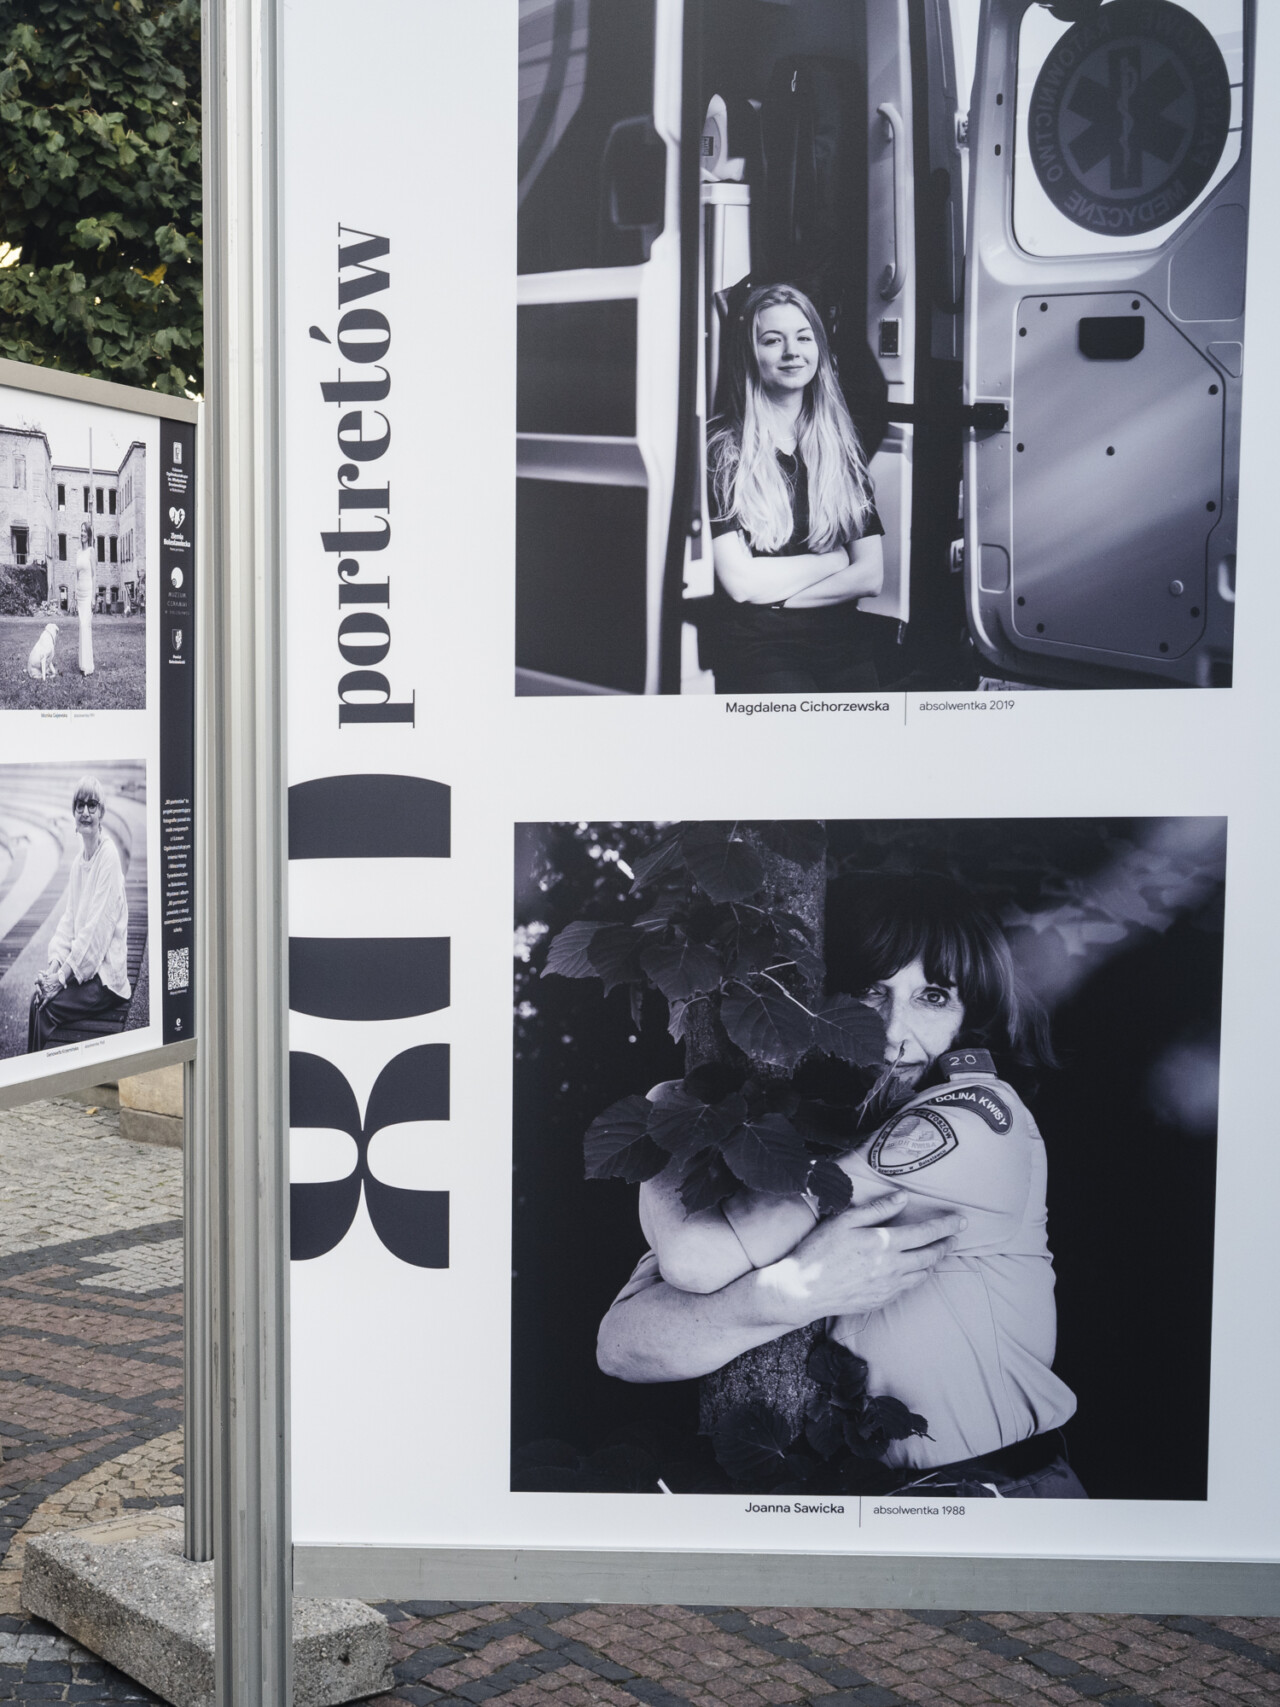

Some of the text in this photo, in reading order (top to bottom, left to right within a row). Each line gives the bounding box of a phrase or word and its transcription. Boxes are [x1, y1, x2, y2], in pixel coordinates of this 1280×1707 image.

[308, 222, 415, 729] portretów
[725, 700, 890, 716] Magdalena Cichorzewska
[919, 700, 1015, 711] absolwentka 2019
[949, 1054, 977, 1066] 20
[935, 1092, 1008, 1126] DOLINA KWISY
[745, 1502, 845, 1514] Joanna Sawicka
[873, 1504, 966, 1516] absolwentka 1988
